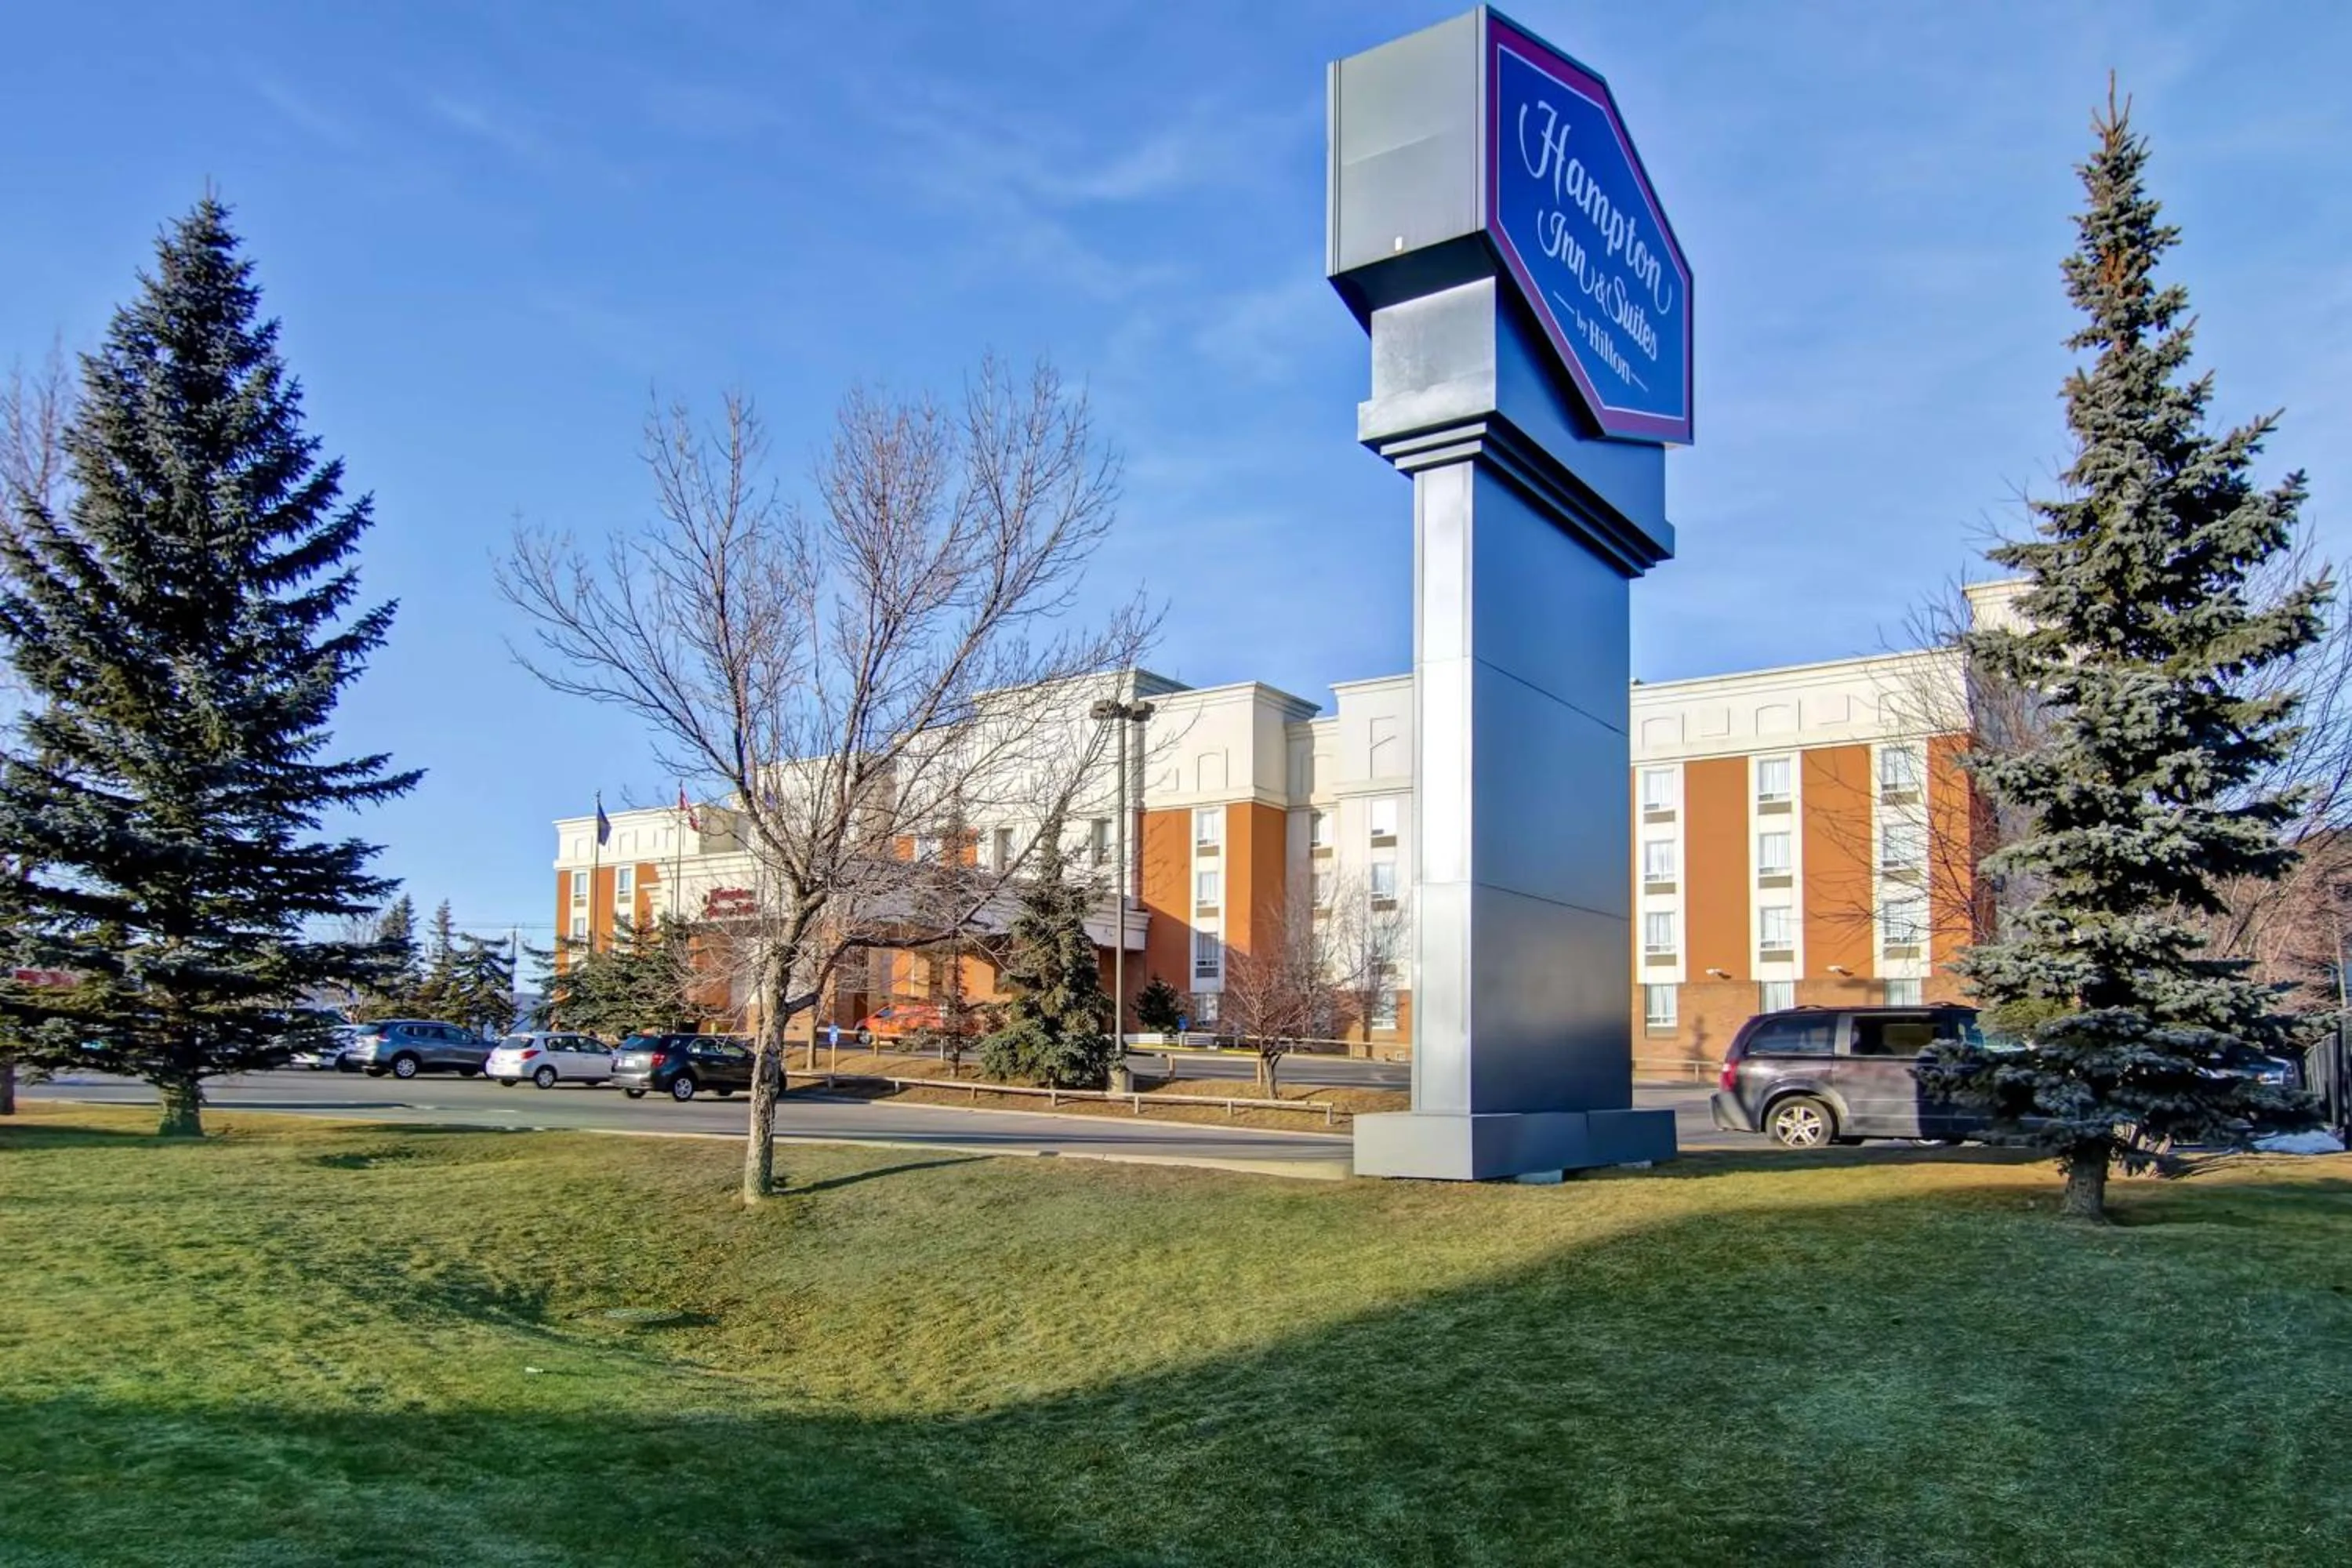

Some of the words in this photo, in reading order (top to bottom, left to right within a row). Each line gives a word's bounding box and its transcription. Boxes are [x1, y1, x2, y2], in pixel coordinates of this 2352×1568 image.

[1519, 100, 1672, 314] Hampton
[1537, 209, 1595, 294] Inn
[1594, 272, 1609, 317] &
[1606, 275, 1657, 361] Suites
[1577, 309, 1588, 338] by
[1588, 318, 1631, 385] Hilton
